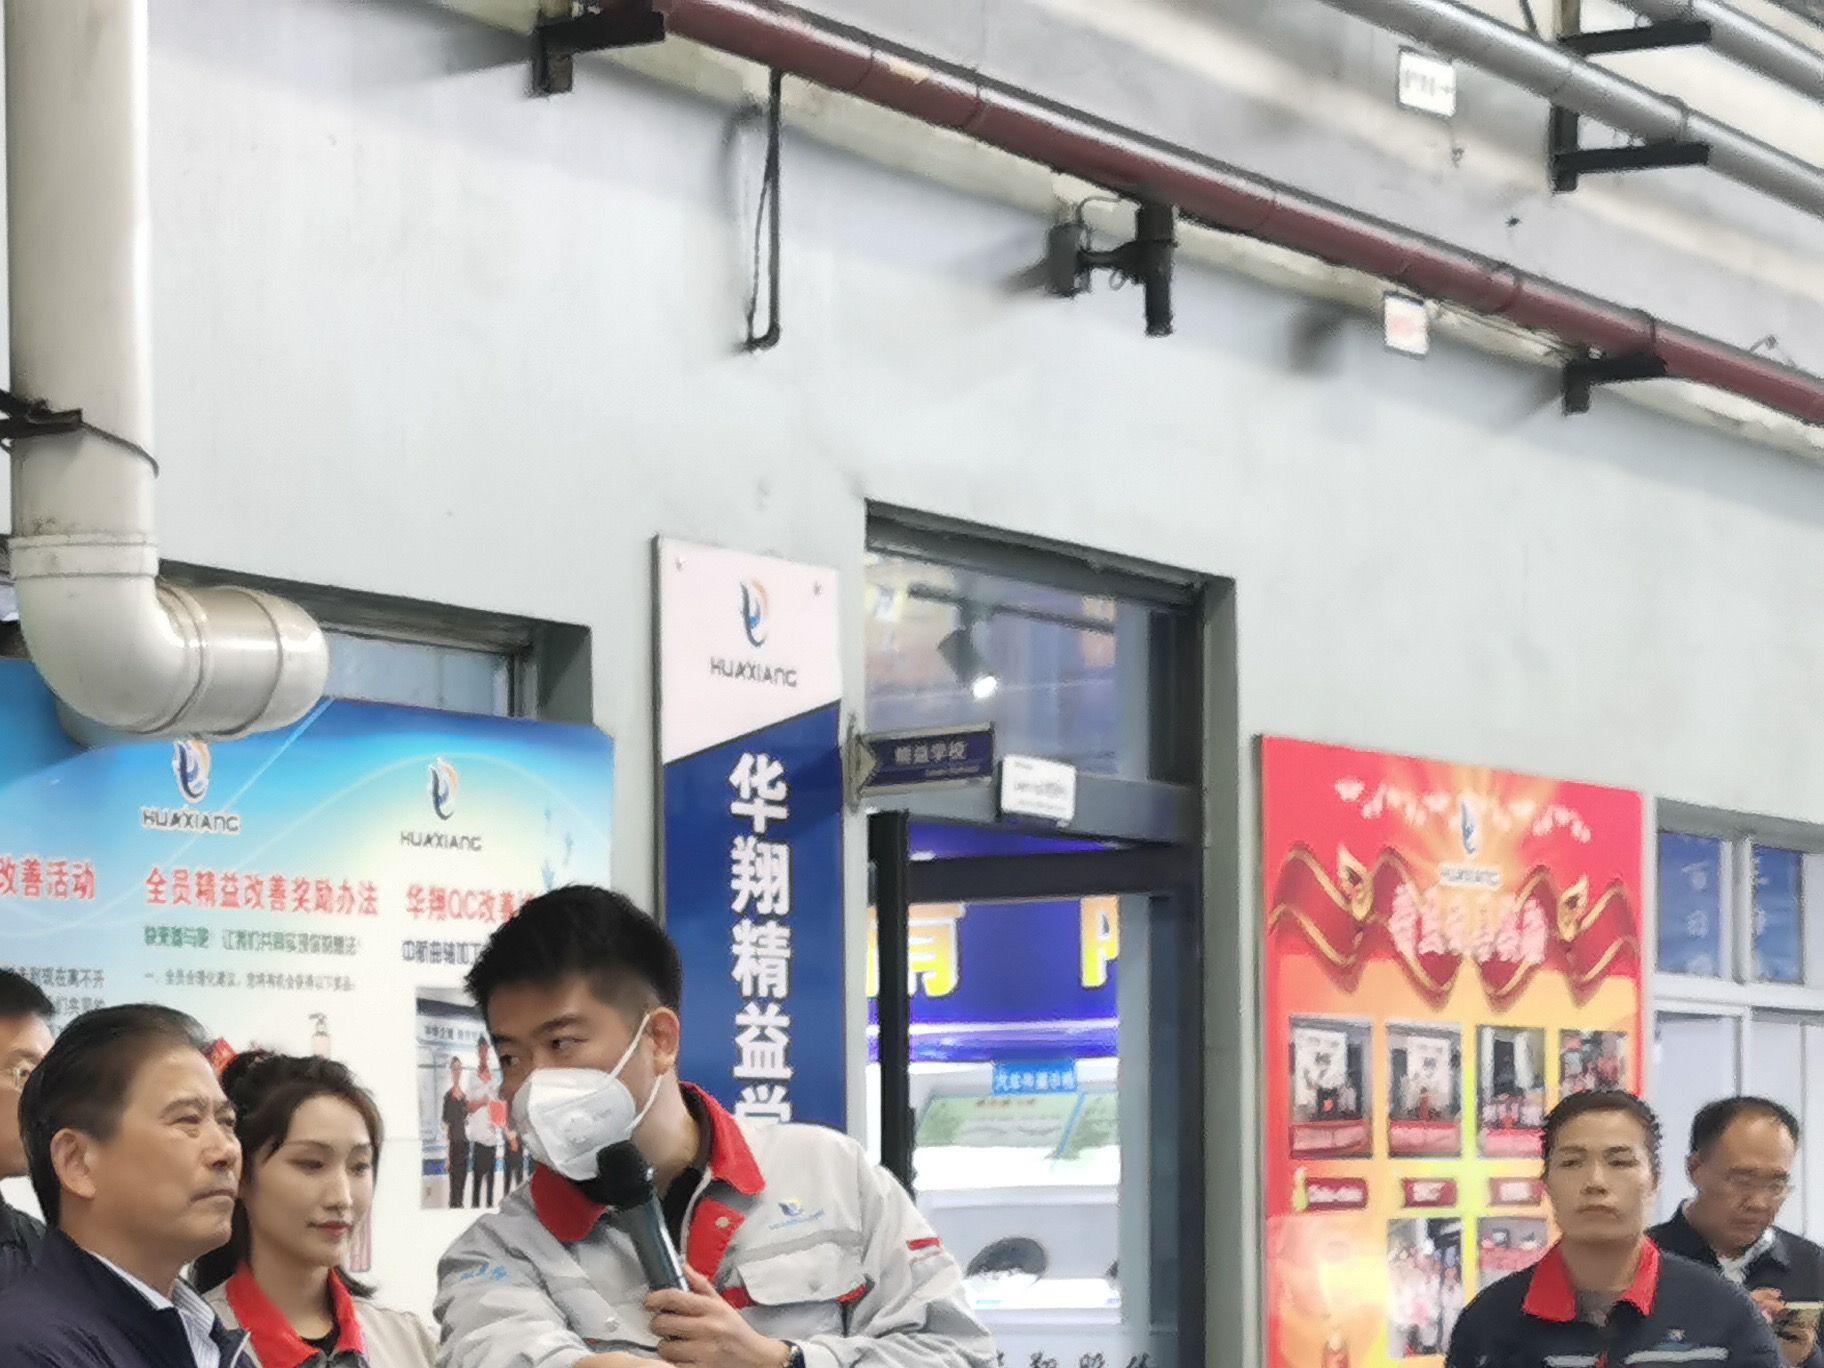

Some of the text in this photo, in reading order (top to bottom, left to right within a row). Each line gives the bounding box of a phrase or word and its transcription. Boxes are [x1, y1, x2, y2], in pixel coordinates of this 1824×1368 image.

[710, 656, 798, 687] HUAXIANG
[142, 809, 239, 832] HUAXIANG
[400, 831, 482, 851] HUAXIANG
[145, 867, 378, 916] 全员精益改善奖励办法
[406, 884, 536, 922] 华翔QC改善
